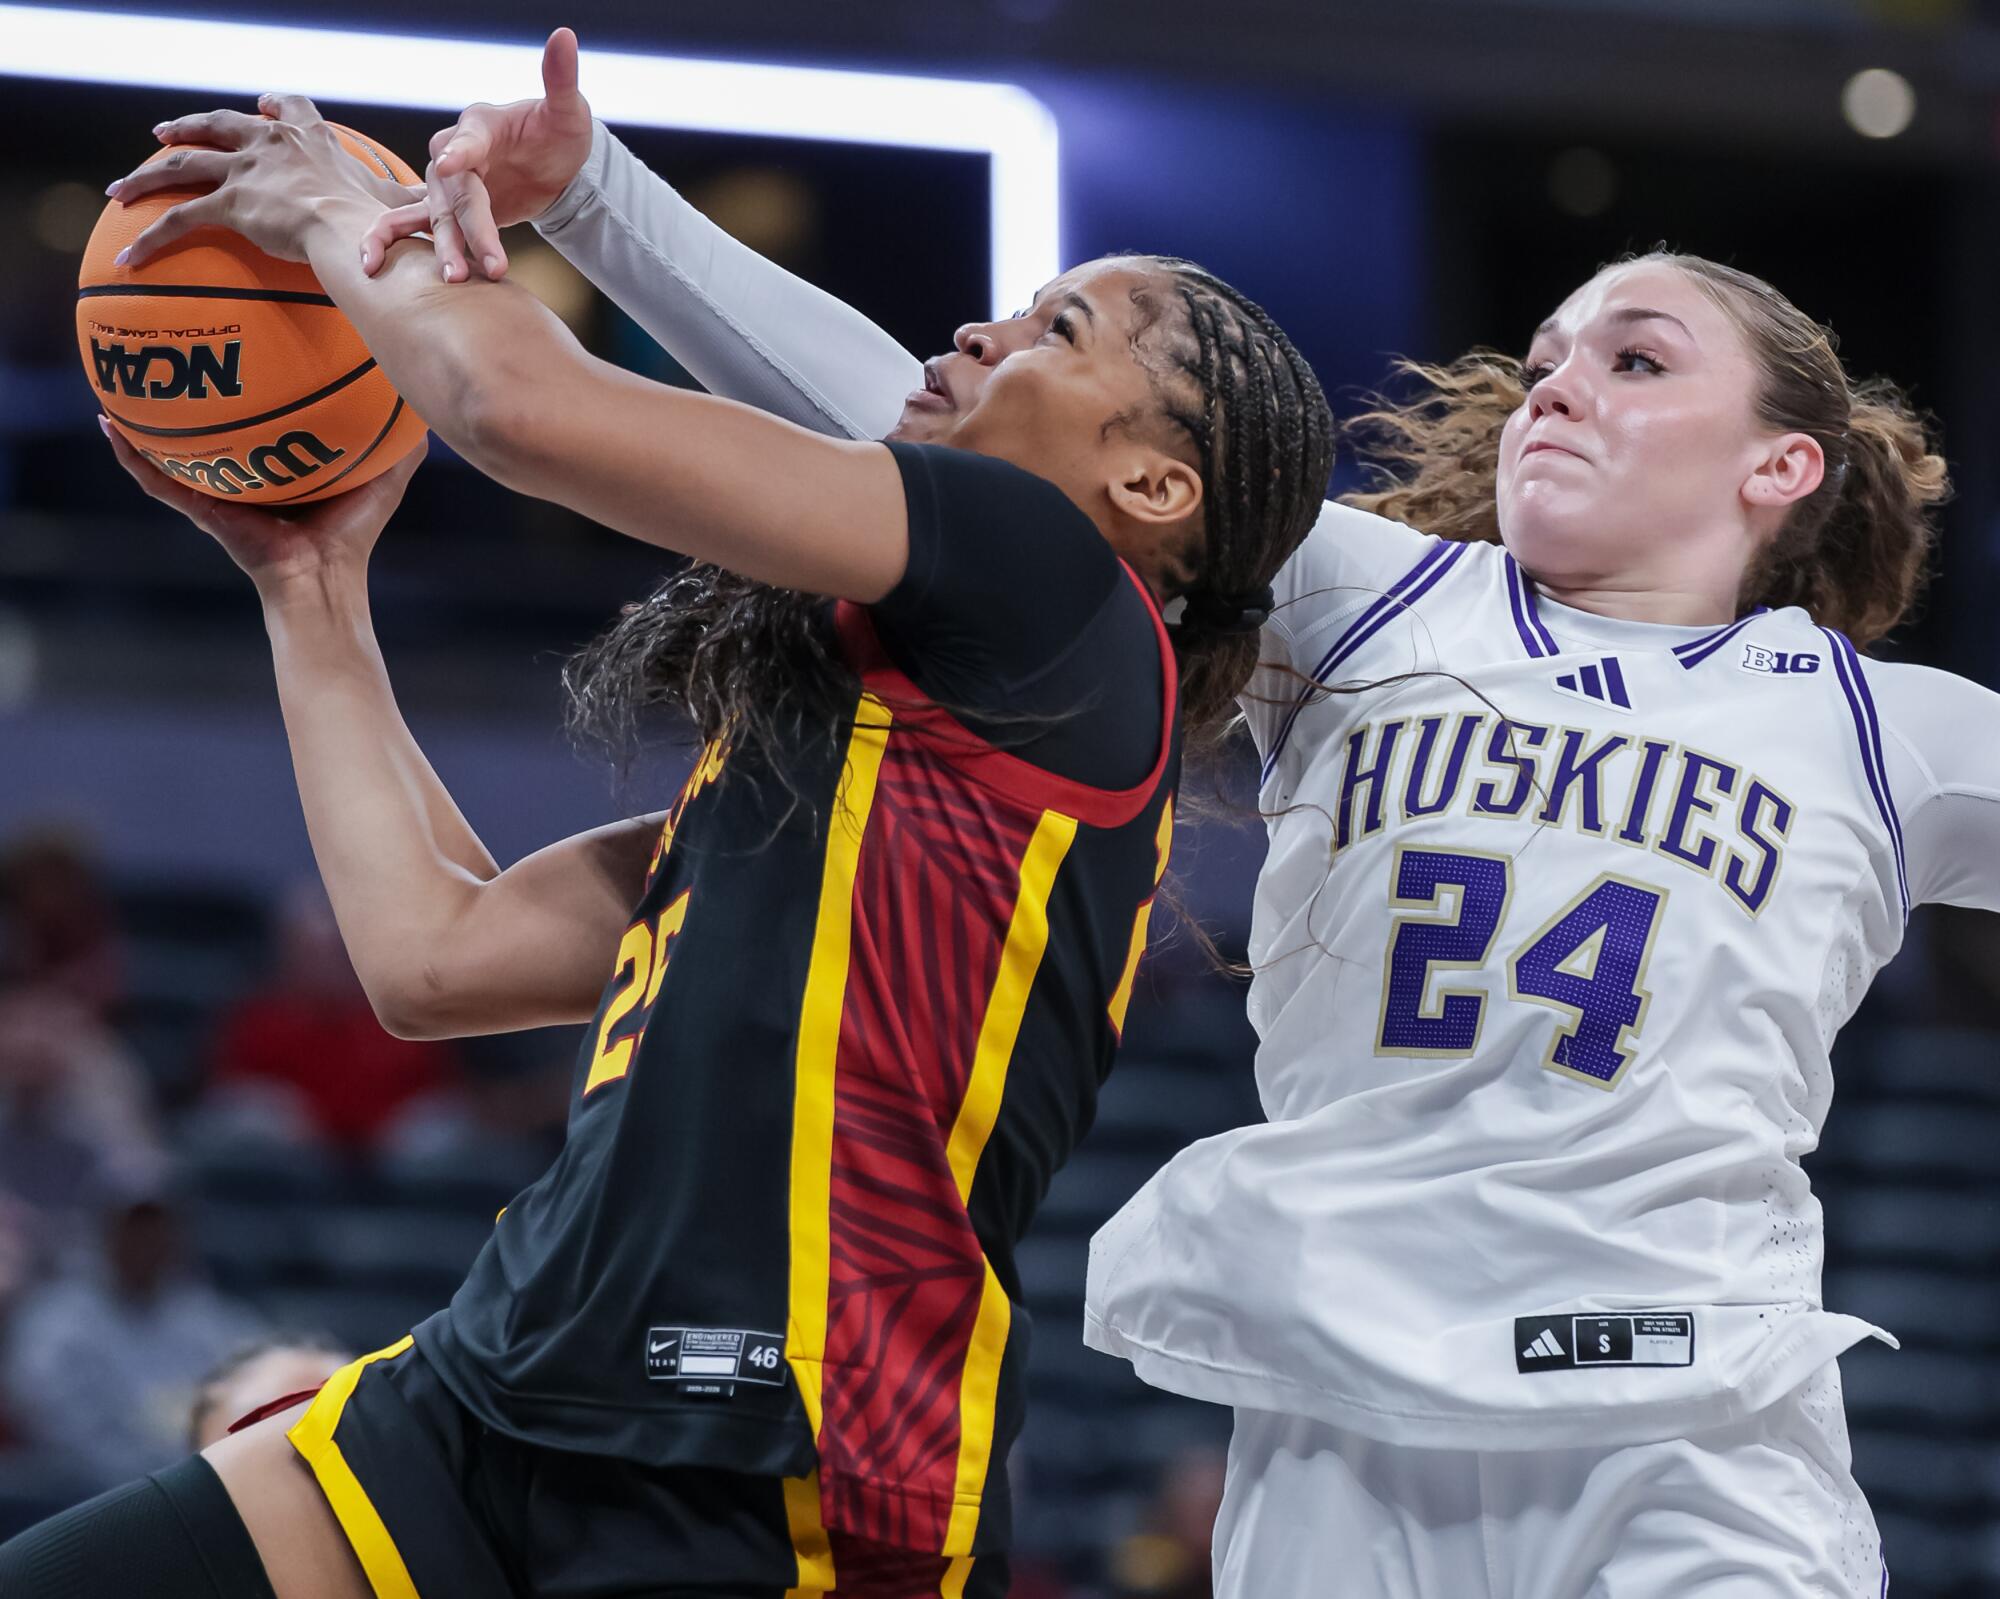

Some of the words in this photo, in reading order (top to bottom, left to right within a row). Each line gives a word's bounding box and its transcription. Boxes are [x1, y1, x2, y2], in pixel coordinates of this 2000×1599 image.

[88, 320, 115, 336] BALL
[117, 327, 159, 339] GAME
[162, 324, 241, 339] OFFICIAL
[91, 337, 243, 399] NCAA
[139, 430, 346, 494] Wils
[1334, 711, 1797, 920] HUSKIES
[1374, 843, 1670, 1092] 24
[1598, 1334, 1611, 1353] S
[748, 1346, 779, 1369] 46
